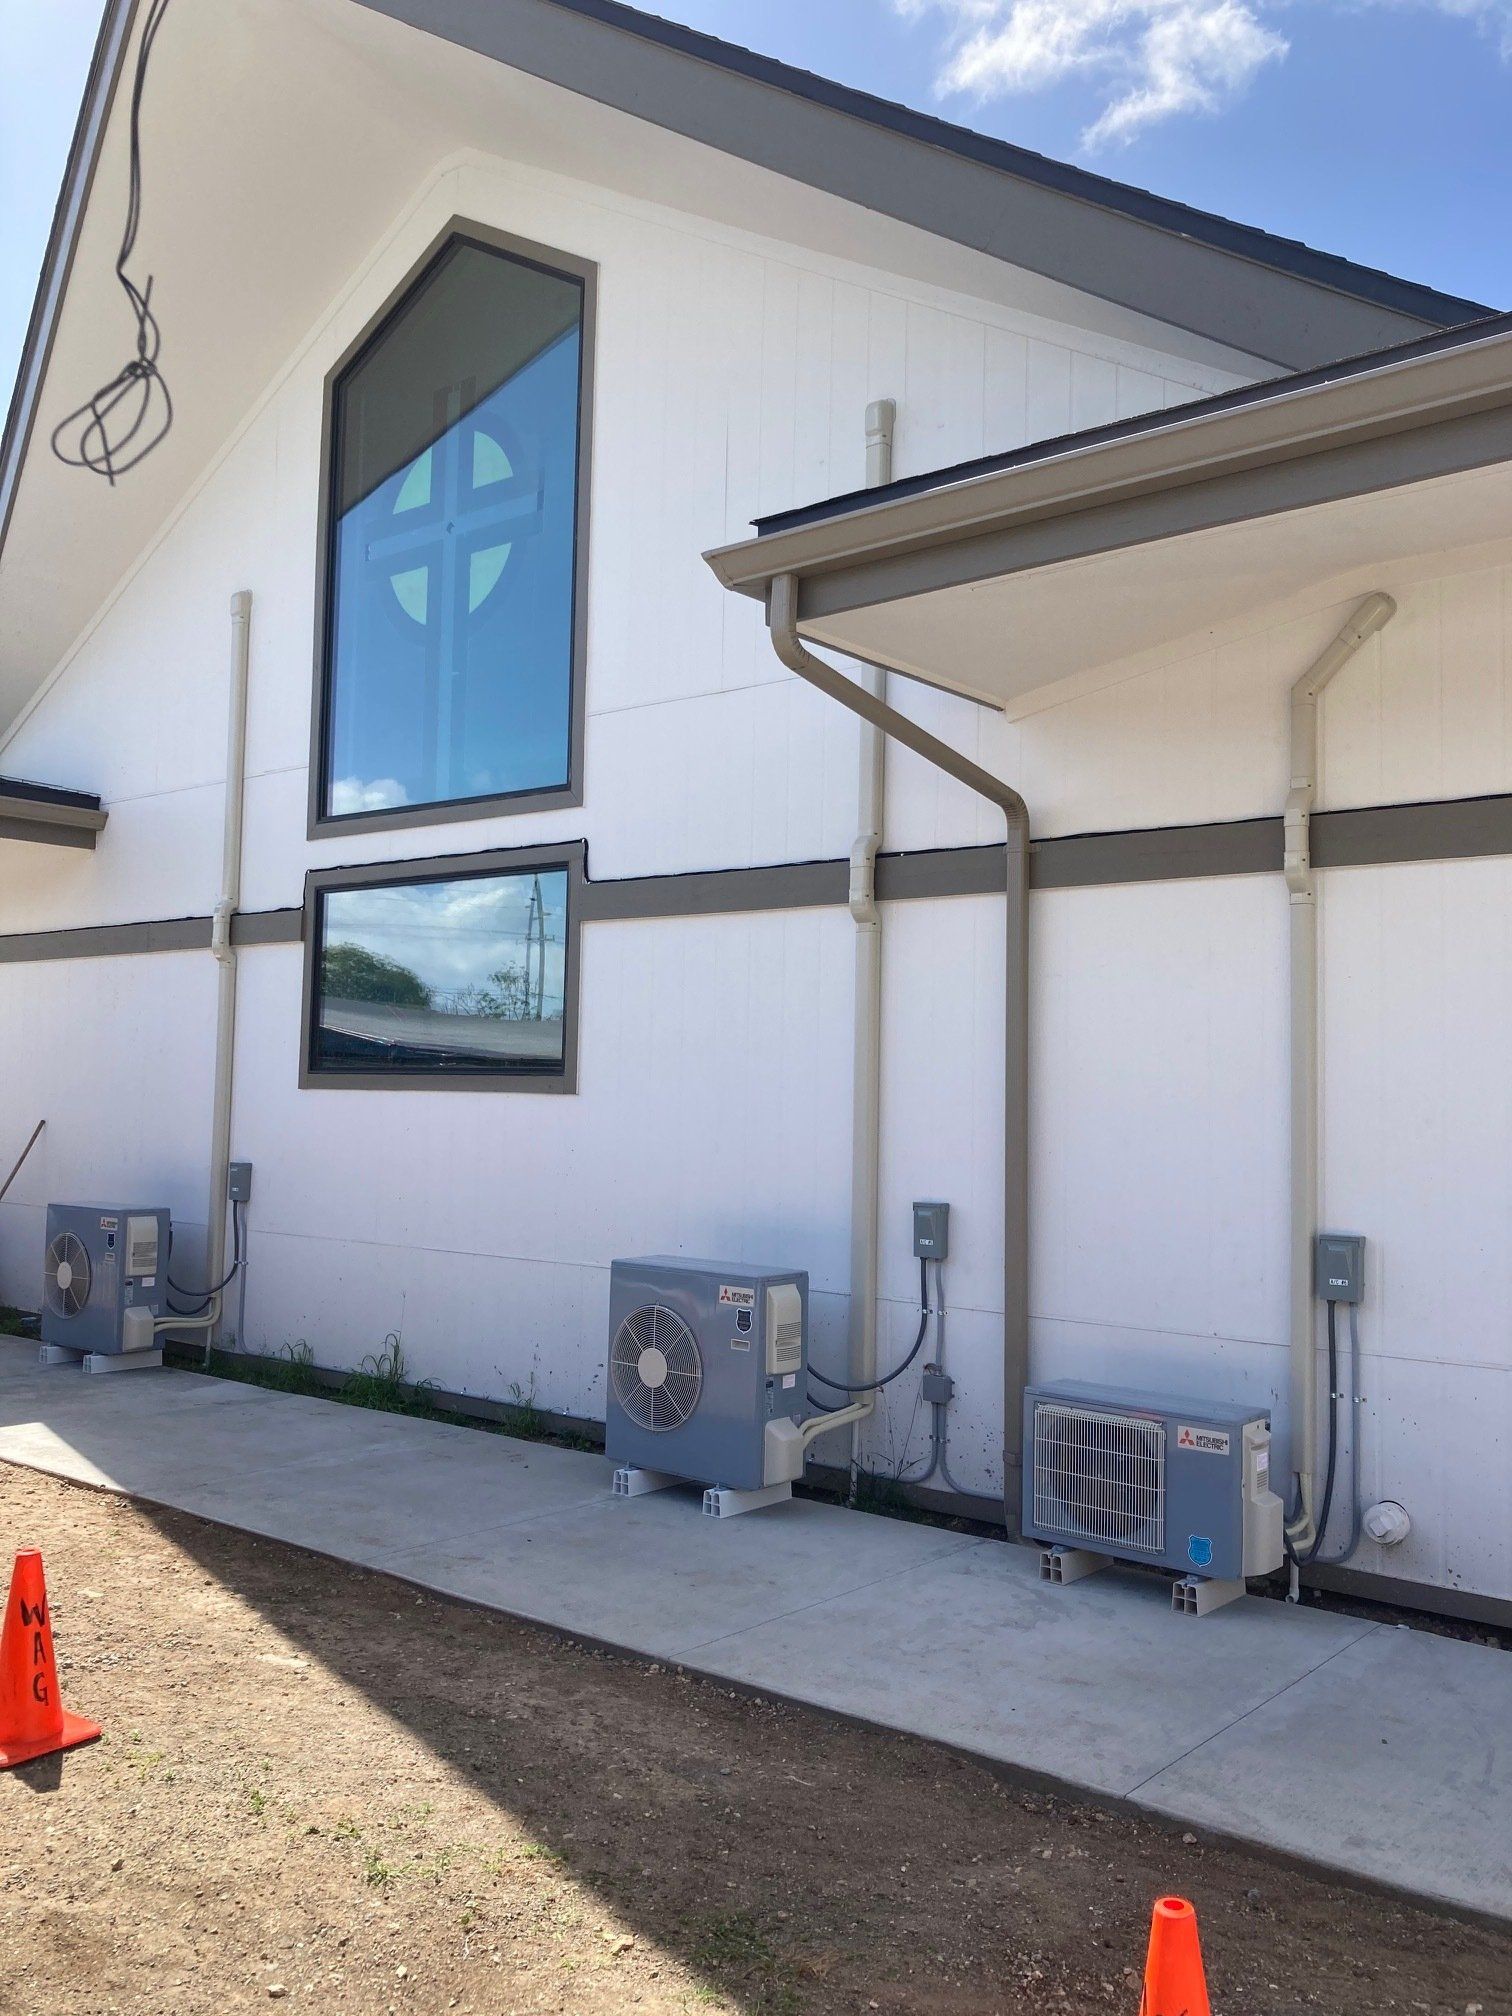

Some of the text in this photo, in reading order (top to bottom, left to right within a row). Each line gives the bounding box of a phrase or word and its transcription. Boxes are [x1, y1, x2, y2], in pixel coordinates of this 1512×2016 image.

[1196, 1435, 1228, 1445] MITSUBISHI
[1196, 1441, 1224, 1451] ELECTRIC
[20, 1593, 49, 1706] WAG
